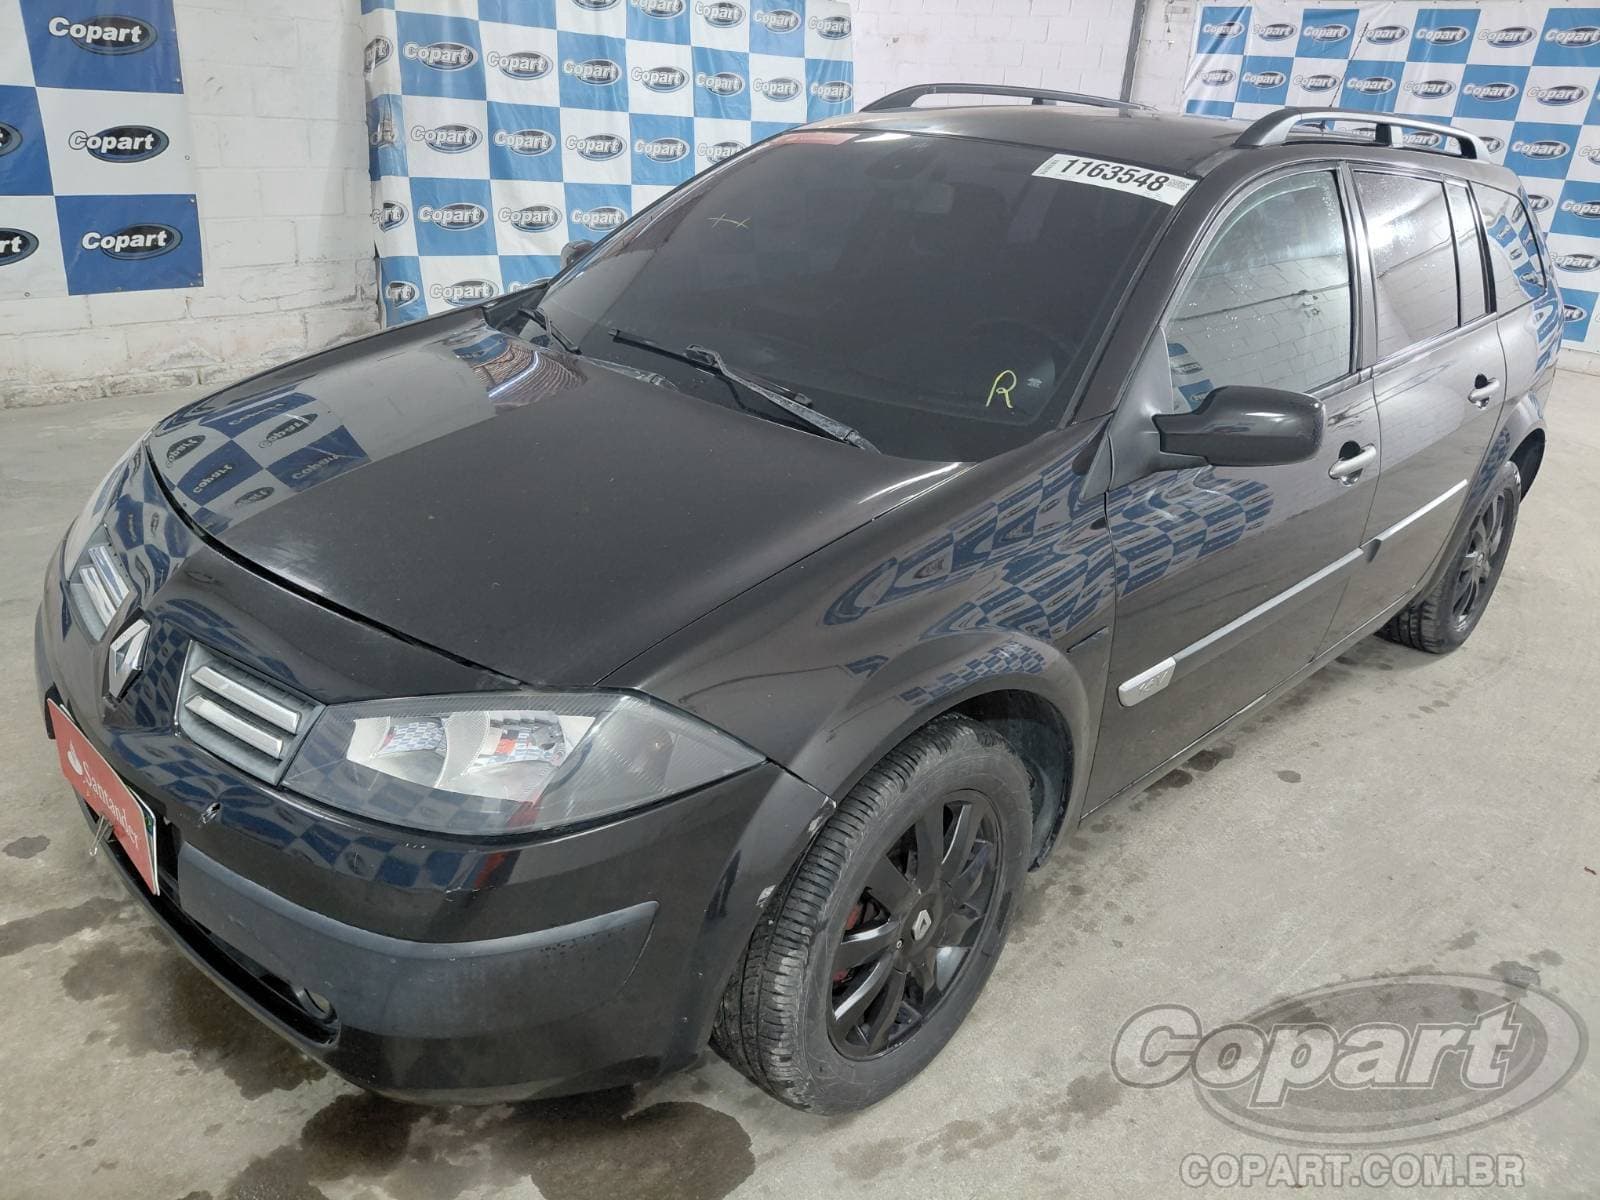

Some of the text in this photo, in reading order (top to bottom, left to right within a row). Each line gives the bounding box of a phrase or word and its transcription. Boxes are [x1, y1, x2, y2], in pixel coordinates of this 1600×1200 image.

[695, 3, 740, 22] Copart
[753, 10, 796, 27] Copart
[49, 17, 142, 42] Copart
[809, 16, 850, 34] Copart
[1304, 26, 1344, 40] Copart
[1416, 28, 1464, 44] Copart
[1479, 29, 1530, 45] Copart
[404, 42, 469, 65] Copart
[487, 51, 546, 73] Copart
[563, 60, 617, 80] Copart
[632, 67, 682, 84] Copart
[696, 73, 740, 91] Copart
[753, 79, 797, 96] Copart
[810, 83, 849, 99] Copart
[1294, 75, 1334, 90] Copart
[1347, 78, 1391, 92] Copart
[1404, 81, 1450, 98] Copart
[1464, 84, 1512, 100] Copart
[1528, 87, 1580, 104] Copart
[69, 131, 154, 153] Copart
[411, 126, 473, 148] Copart
[495, 131, 549, 152] Copart
[566, 135, 619, 155] Copart
[635, 139, 683, 158] Copart
[698, 143, 737, 160] Copar
[1512, 141, 1564, 158] Copart
[1061, 159, 1170, 192] 1163548
[418, 206, 481, 226] Copart
[1561, 200, 1600, 216] Copa
[499, 208, 555, 228] Copart
[572, 209, 625, 228] Copart
[82, 230, 168, 252] Copart
[431, 284, 490, 303] Copart
[986, 370, 1017, 408] R
[82, 760, 139, 850] Santander
